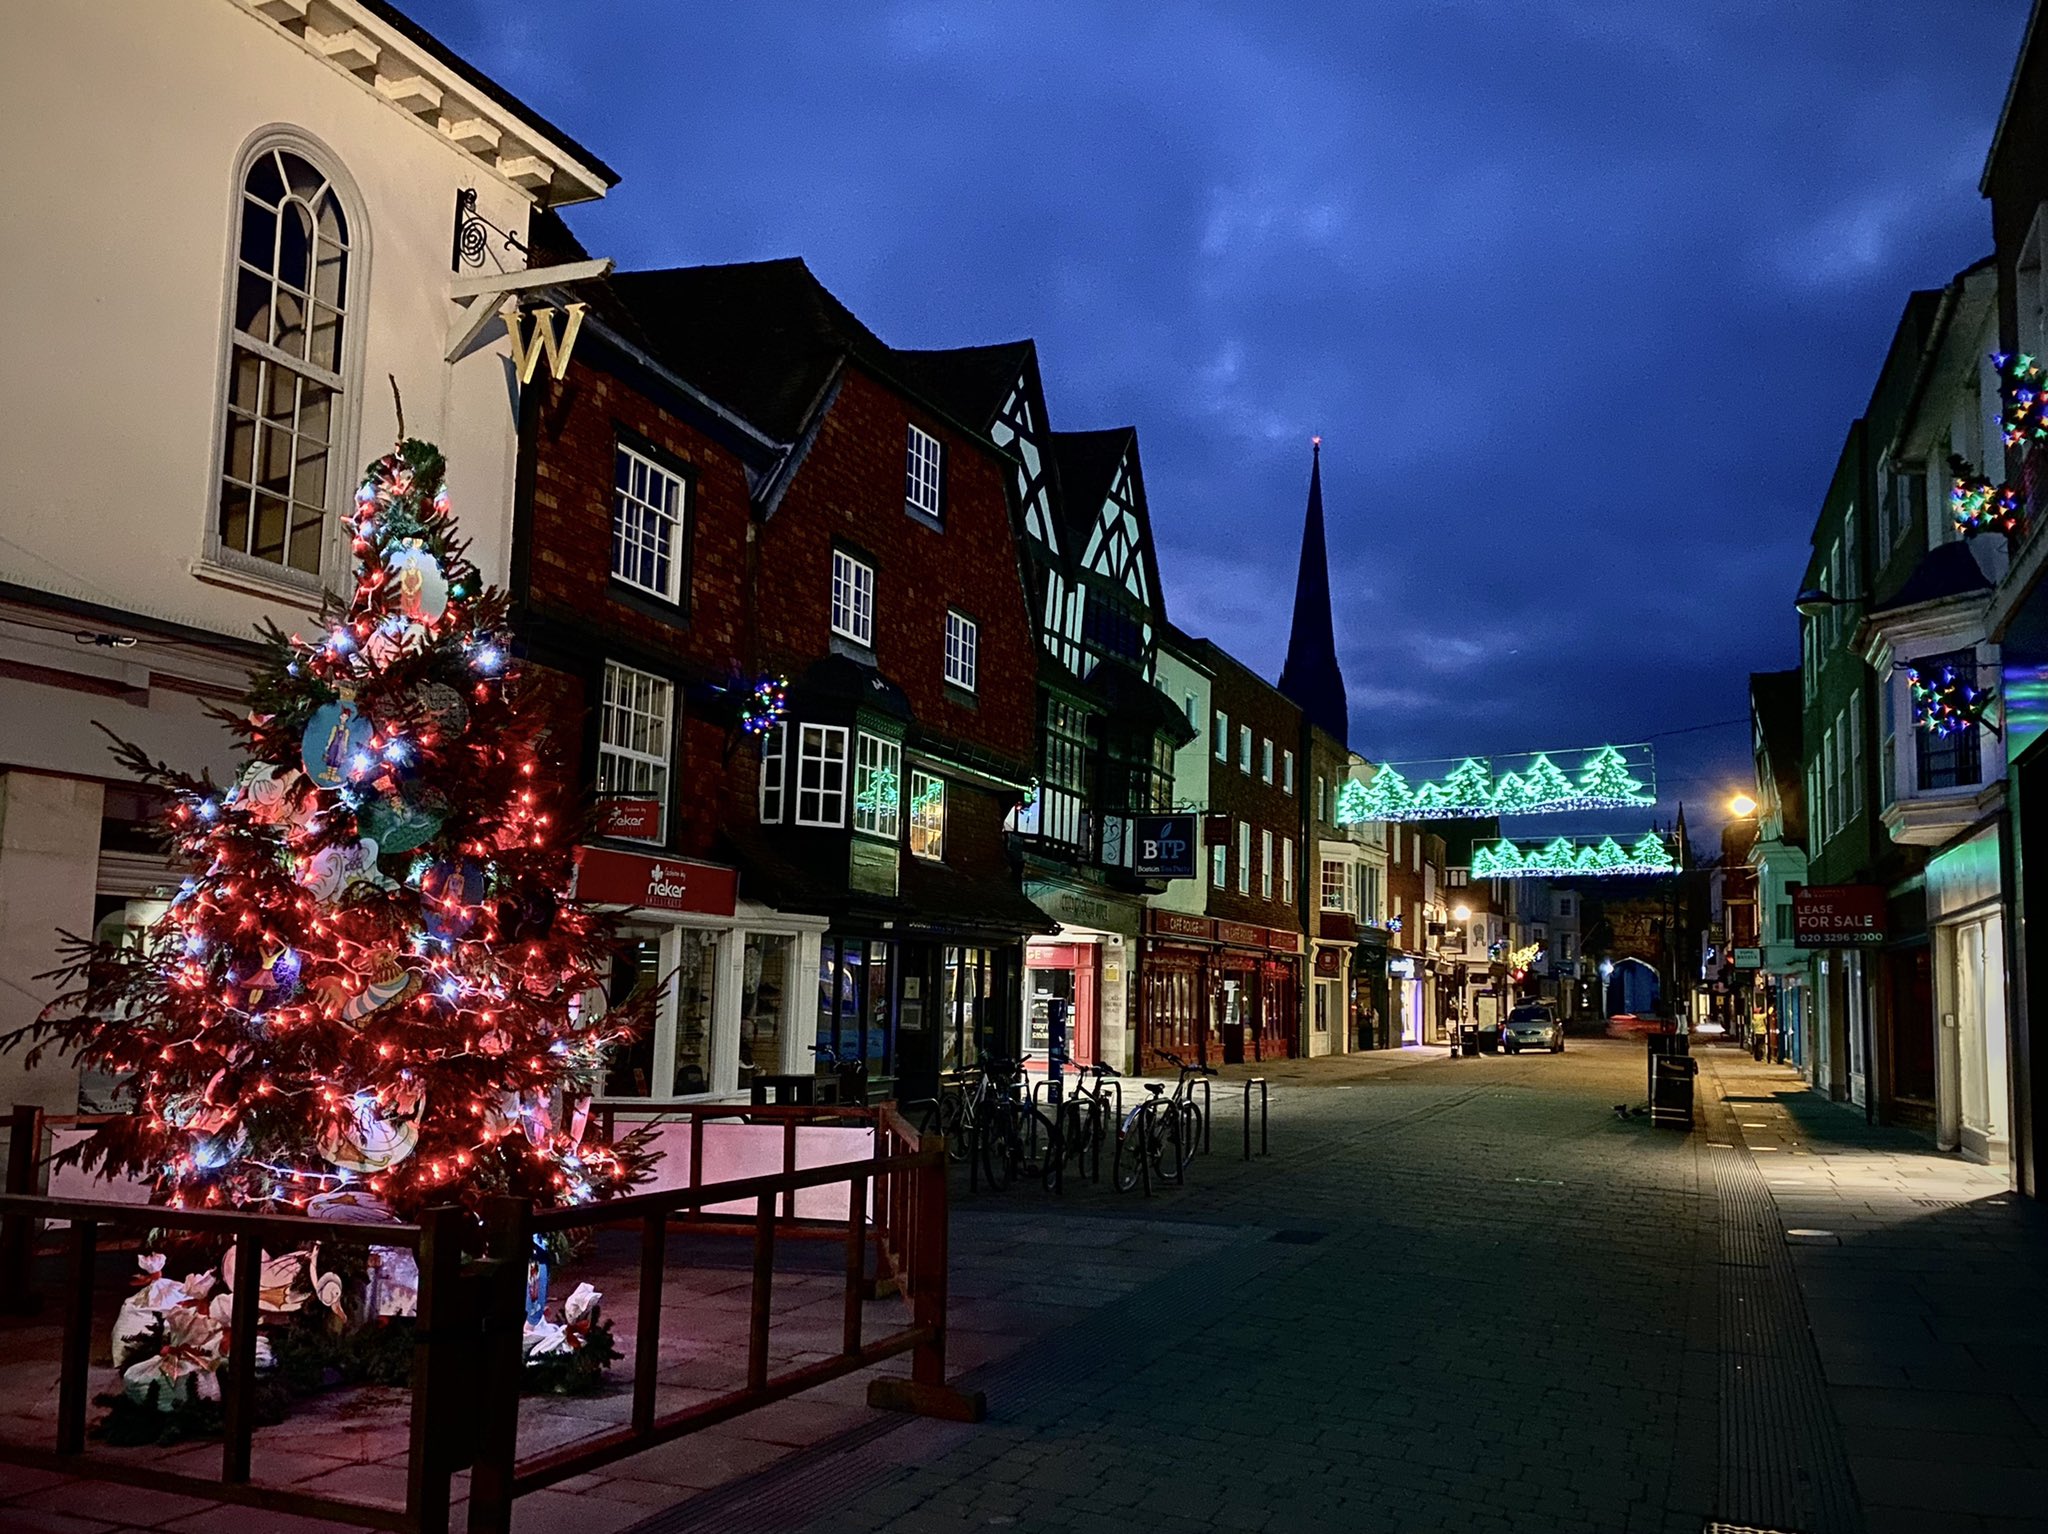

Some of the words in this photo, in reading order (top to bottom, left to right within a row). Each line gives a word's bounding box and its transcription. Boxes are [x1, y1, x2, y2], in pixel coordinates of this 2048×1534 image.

[499, 302, 590, 384] W
[1143, 839, 1186, 860] BTP
[648, 879, 686, 898] rieker
[1797, 904, 1834, 915] LEASE
[1798, 915, 1830, 928] FOR
[1833, 914, 1874, 927] SALE
[1799, 933, 1821, 942] 020
[1823, 933, 1850, 942] 3296
[1853, 932, 1884, 941] 2000
